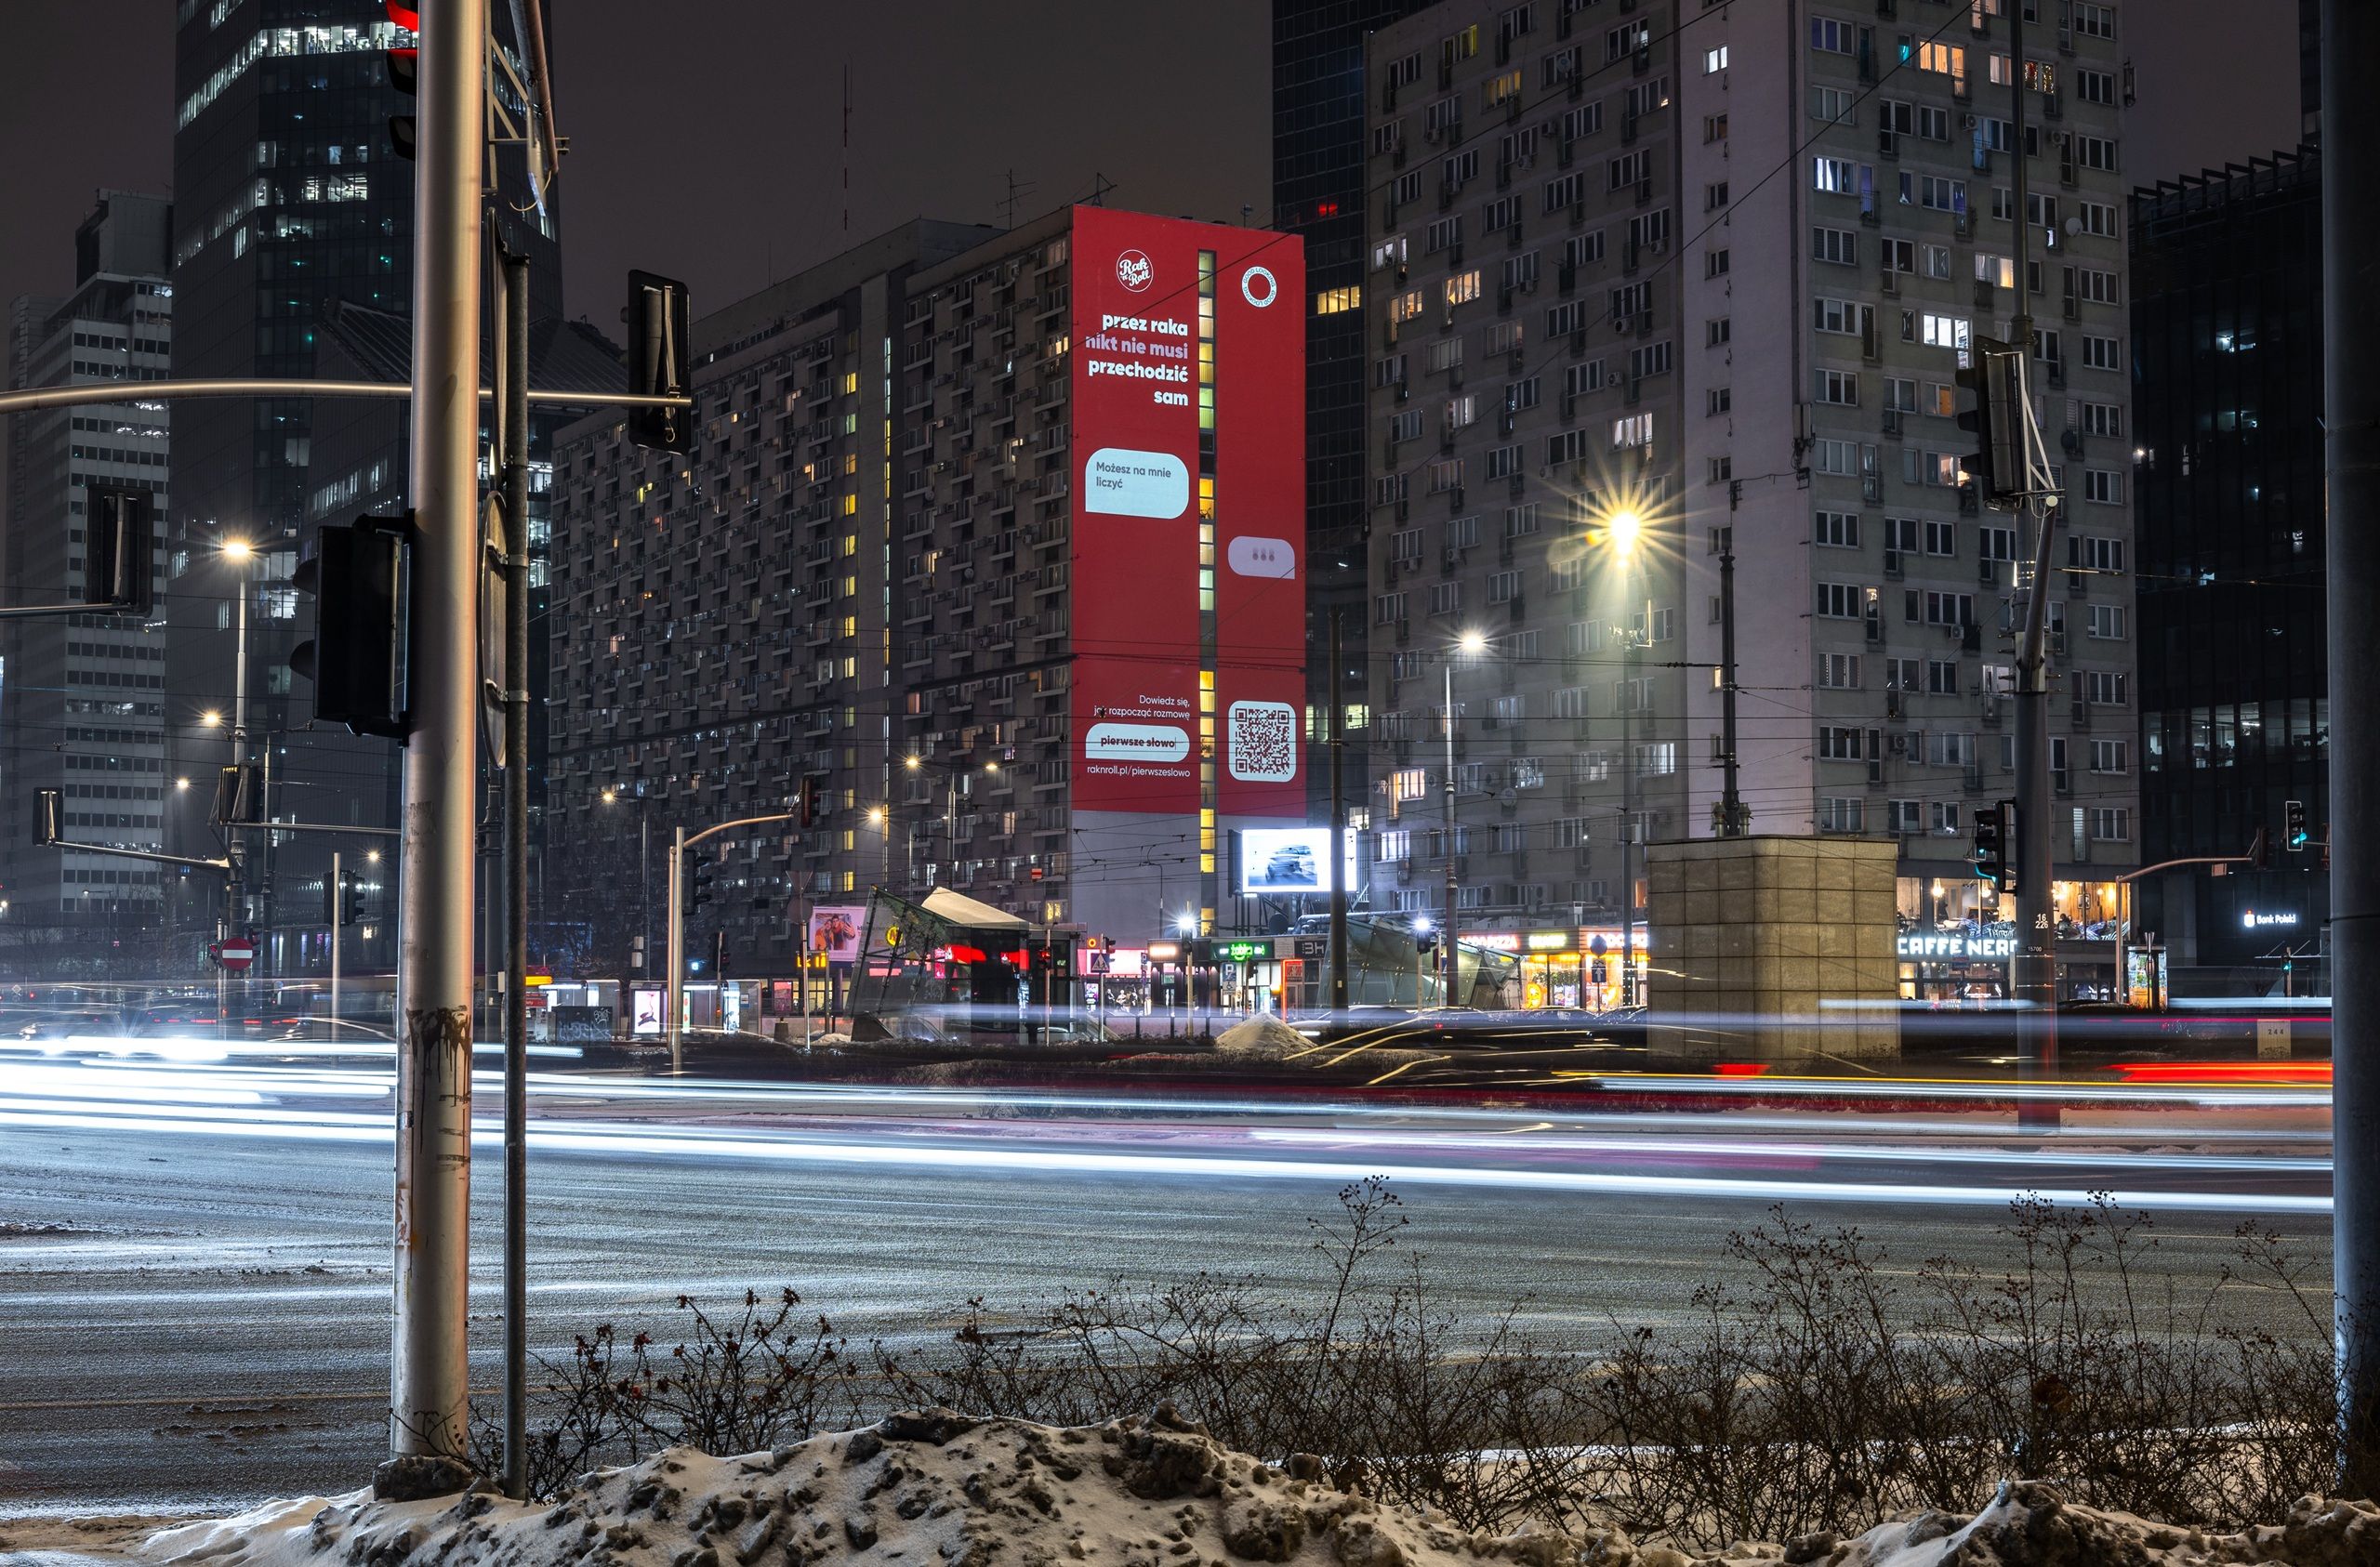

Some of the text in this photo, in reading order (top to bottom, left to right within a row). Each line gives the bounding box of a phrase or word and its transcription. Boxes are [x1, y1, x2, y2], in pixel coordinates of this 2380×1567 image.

[1119, 257, 1149, 276] Rak
[1128, 269, 1151, 286] Roll
[1103, 314, 1188, 336] przez raka
[1085, 333, 1188, 360] nikt nie musi
[1089, 360, 1188, 383] przechodzić
[1154, 390, 1188, 406] sam
[1096, 461, 1171, 478] Możesz na mnie
[1096, 476, 1123, 490] liczyć
[1139, 694, 1190, 708] Dowiedz się,
[1109, 707, 1152, 718] rozpocząć
[1153, 710, 1190, 721] rozmowę
[1101, 735, 1175, 748] pierwsze słowo
[1087, 765, 1191, 778] raknroll.pl/pierwszeslowo
[2035, 921, 2048, 929] 226
[2256, 915, 2274, 924] Bank
